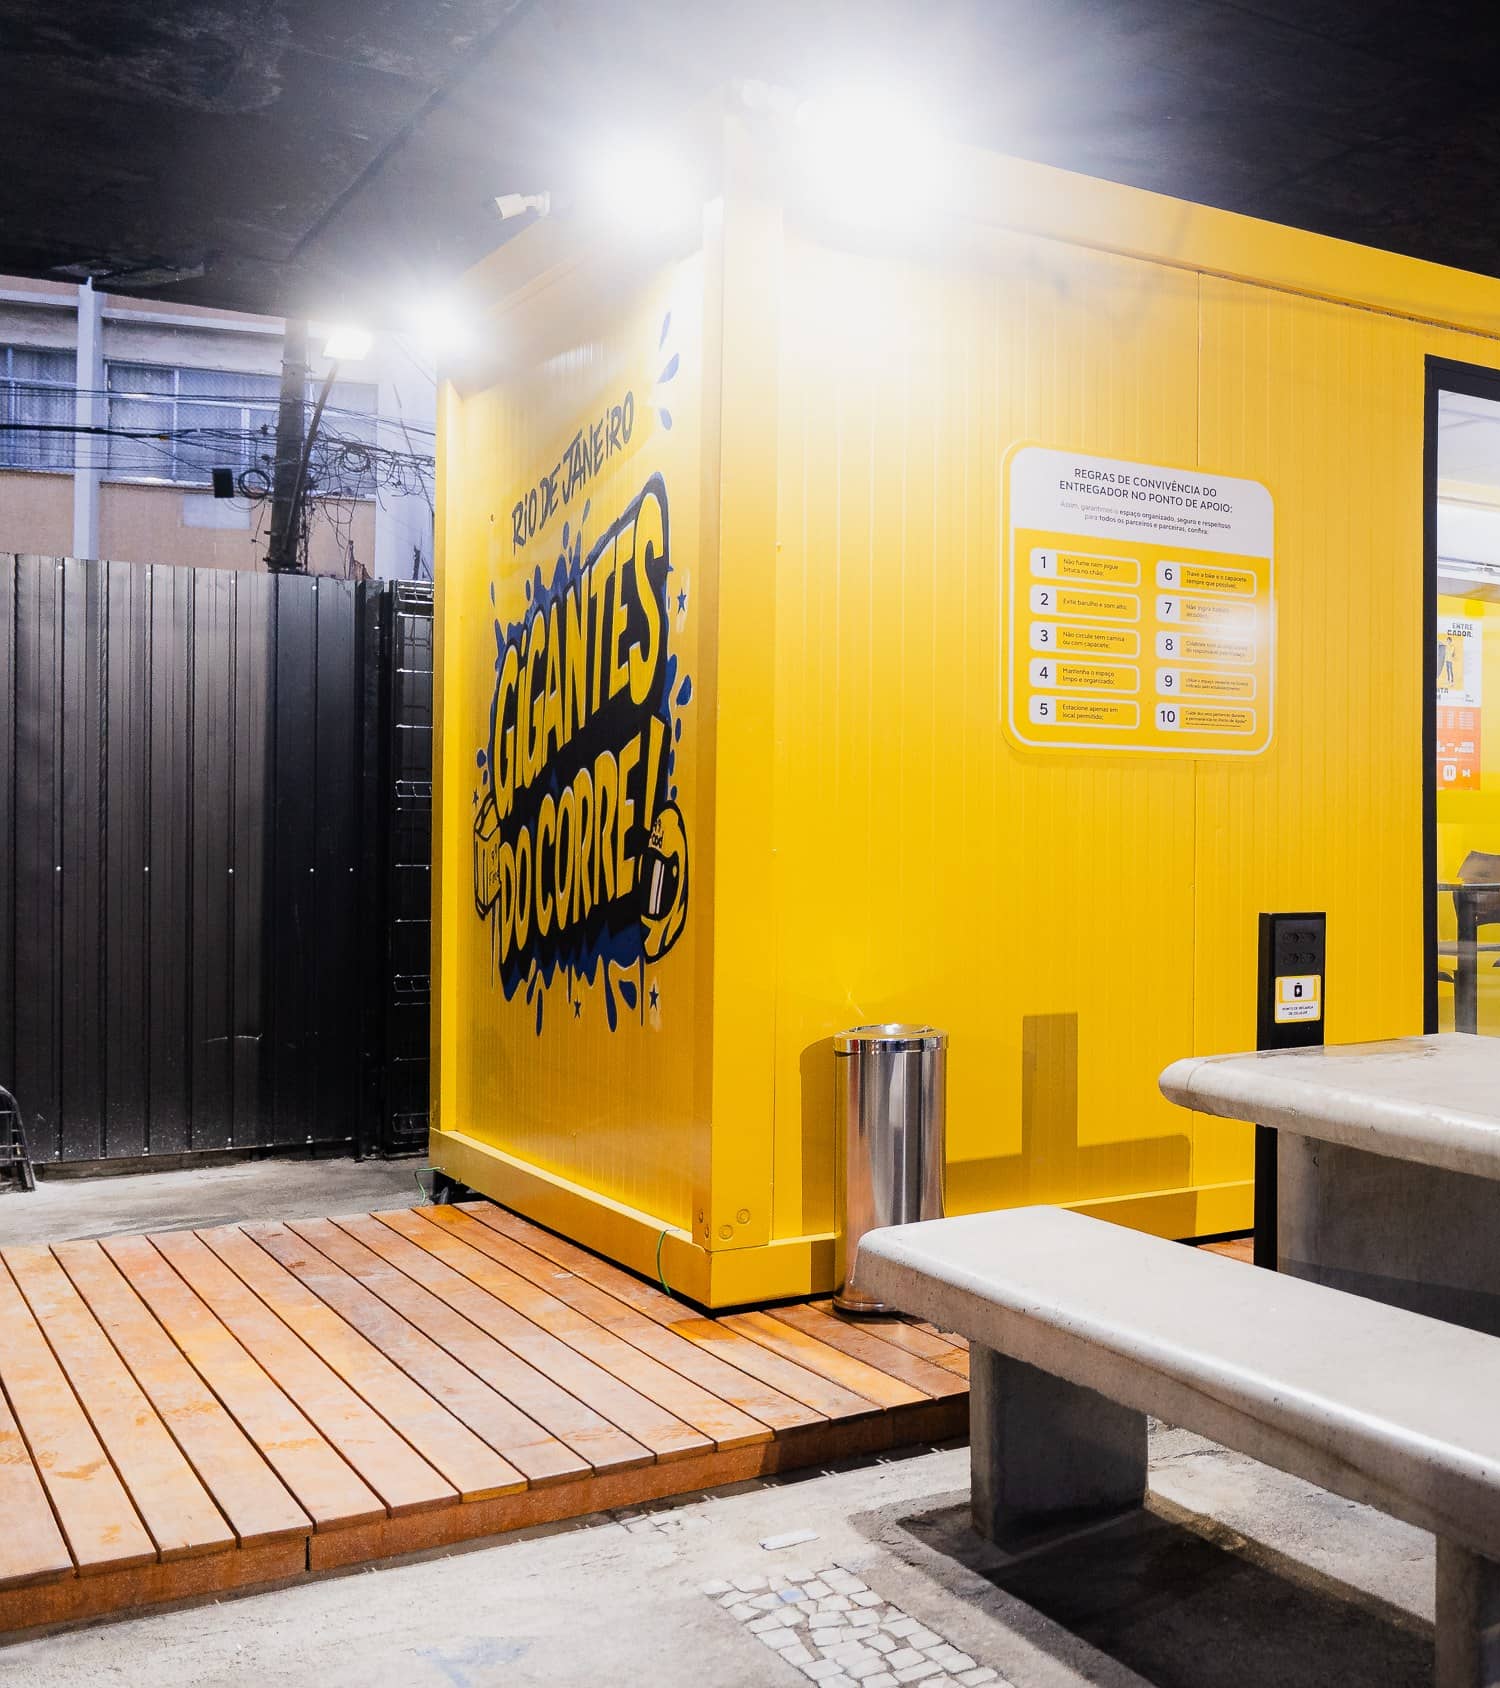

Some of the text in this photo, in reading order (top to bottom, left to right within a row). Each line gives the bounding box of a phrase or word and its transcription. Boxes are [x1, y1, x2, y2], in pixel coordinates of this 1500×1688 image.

[1074, 468, 1216, 497] REGRAS DE CONVIVÊNCIA DO
[540, 463, 561, 530] DE
[1059, 480, 1233, 513] ENTREGADOR NO PONTO DE APOIO:
[1099, 514, 1116, 523] todos
[1040, 556, 1046, 568] 1
[1164, 568, 1172, 580] 6
[1040, 592, 1048, 606] 2
[1164, 602, 1172, 614] 7
[1040, 630, 1048, 642] 3
[1165, 638, 1174, 650] 8
[494, 492, 664, 818] GIGANTES
[1040, 666, 1048, 679] 4
[1164, 675, 1172, 687] 9
[1040, 702, 1048, 716] 5
[1160, 710, 1176, 722] 10
[499, 824, 532, 965] DO
